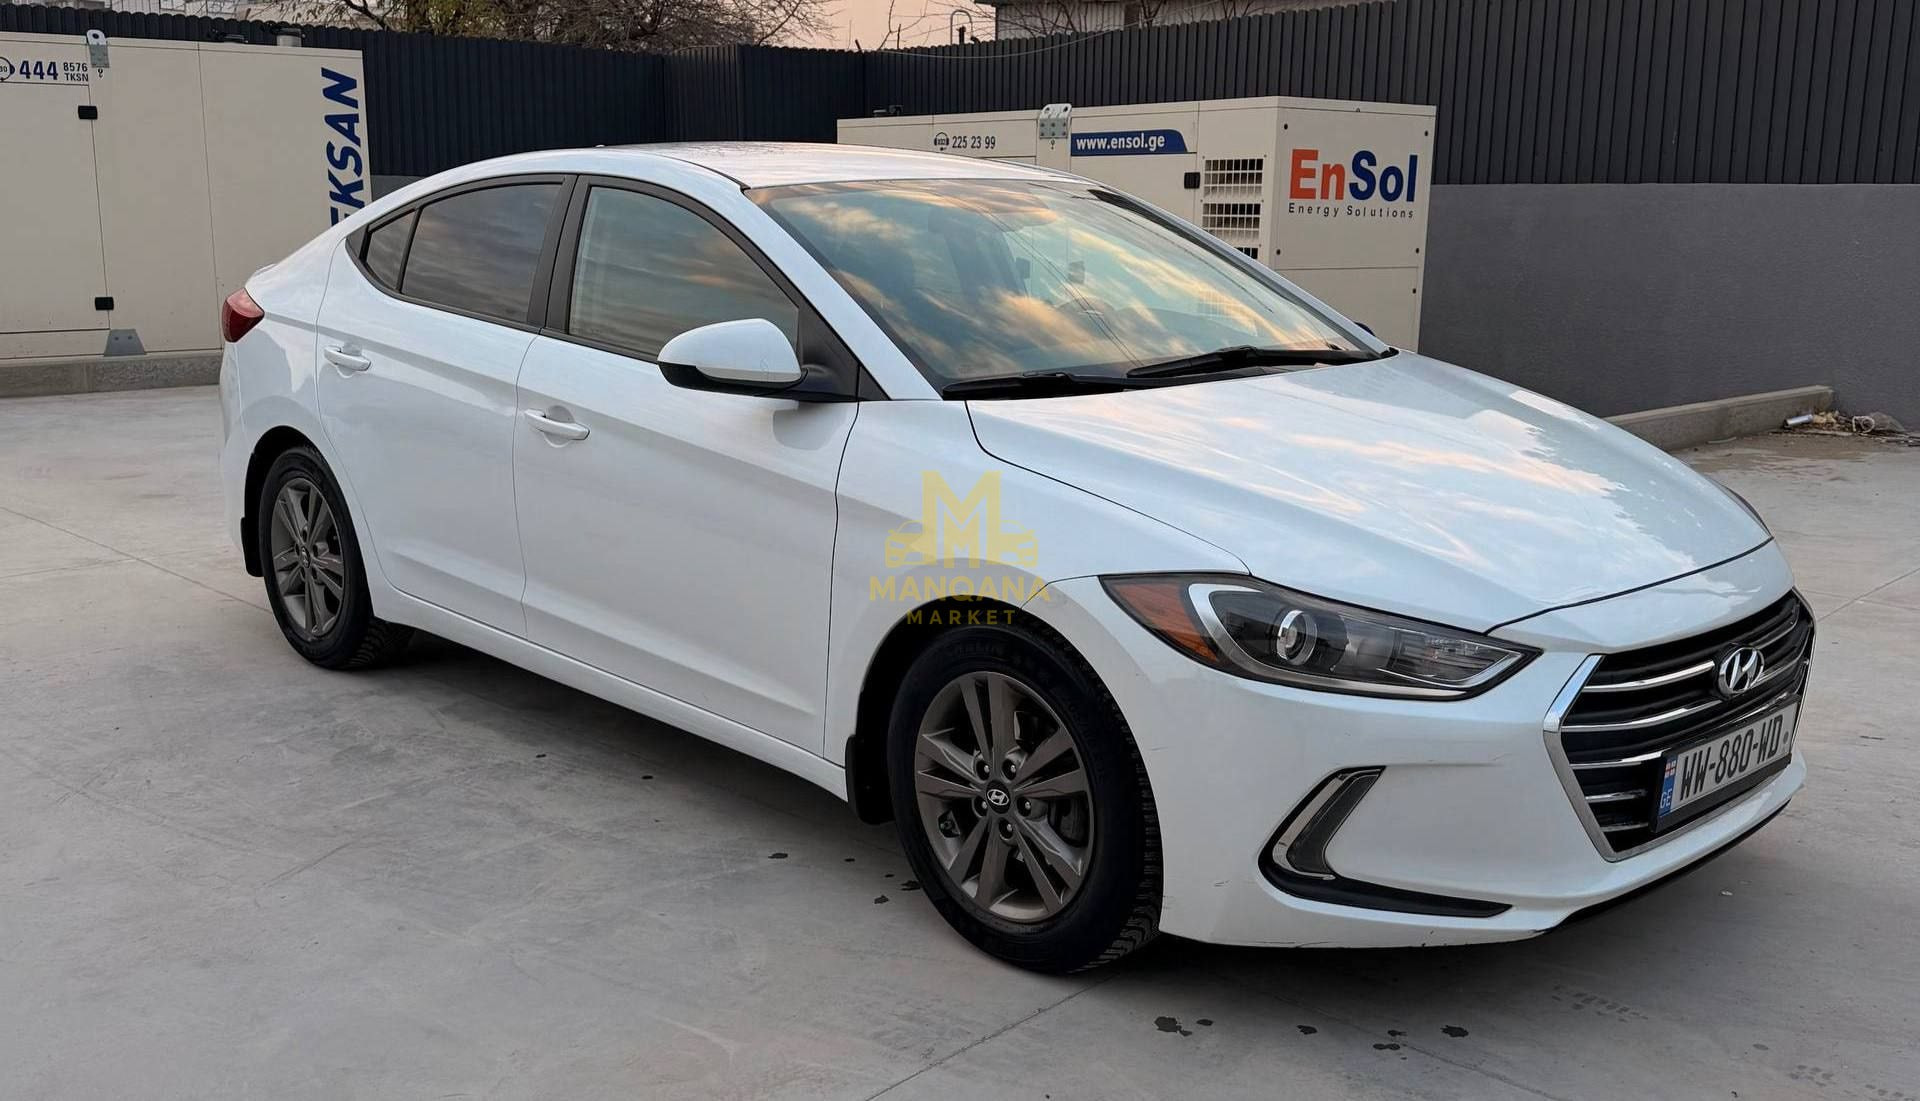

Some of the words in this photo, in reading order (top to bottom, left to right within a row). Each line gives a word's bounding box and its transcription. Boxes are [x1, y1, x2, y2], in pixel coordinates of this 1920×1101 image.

[19, 60, 59, 80] 444
[63, 62, 88, 72] 8576
[64, 72, 89, 82] TKSN
[952, 135, 967, 149] 225
[971, 135, 982, 149] 23
[985, 135, 996, 149] 99
[1076, 132, 1165, 152] www.ensol.ge
[1290, 149, 1418, 202] EnSol
[1288, 202, 1340, 218] Energy
[1347, 205, 1414, 219] Solutions
[1679, 714, 1784, 801] WW-880-WD
[1660, 788, 1673, 809] GE
